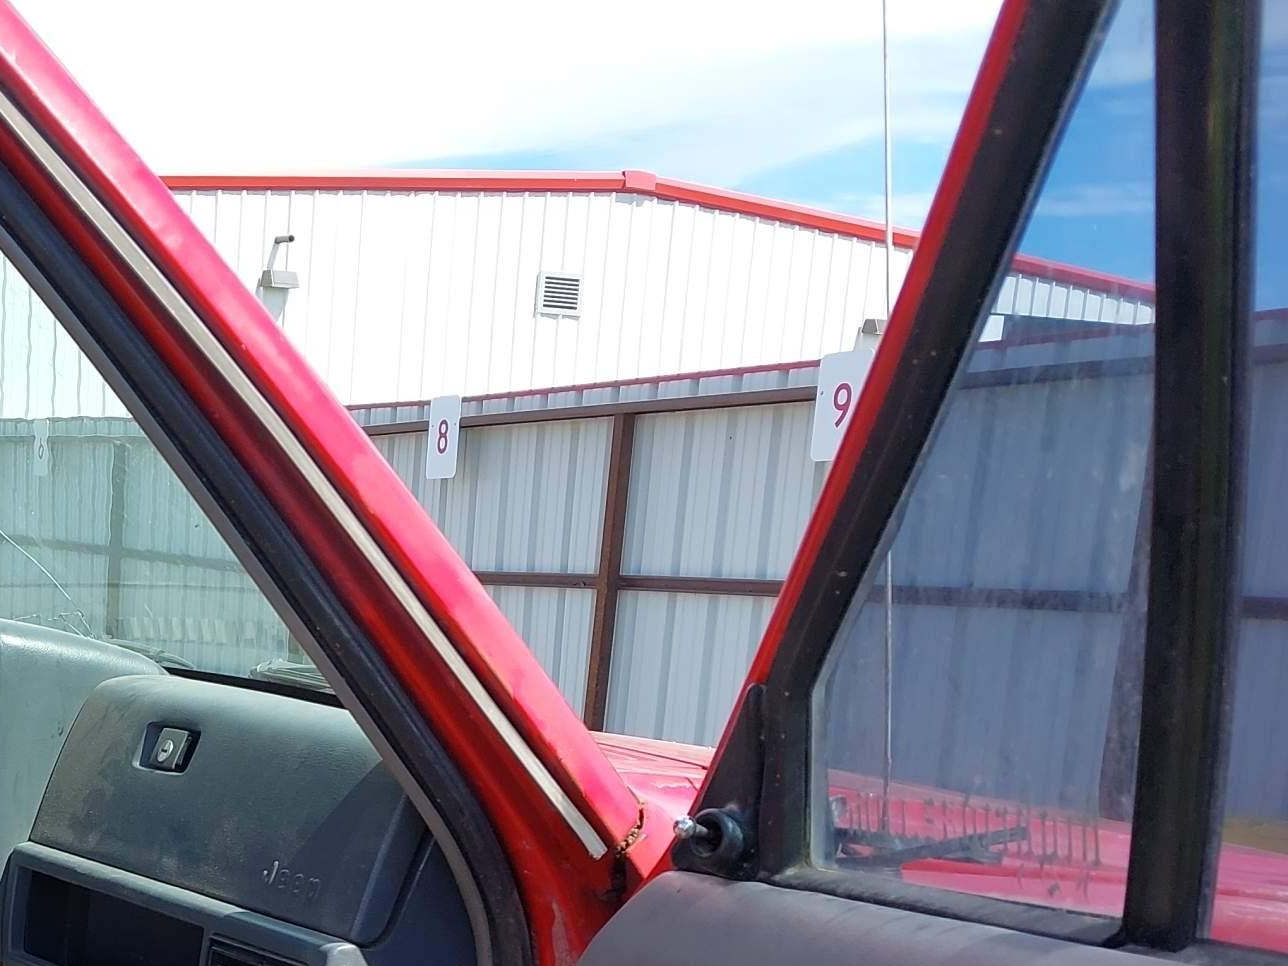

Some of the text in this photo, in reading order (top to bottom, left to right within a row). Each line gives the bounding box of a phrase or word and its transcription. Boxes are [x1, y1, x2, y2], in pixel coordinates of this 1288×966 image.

[834, 383, 852, 428] 9
[438, 419, 449, 454] 8
[263, 860, 321, 900] Jeep
